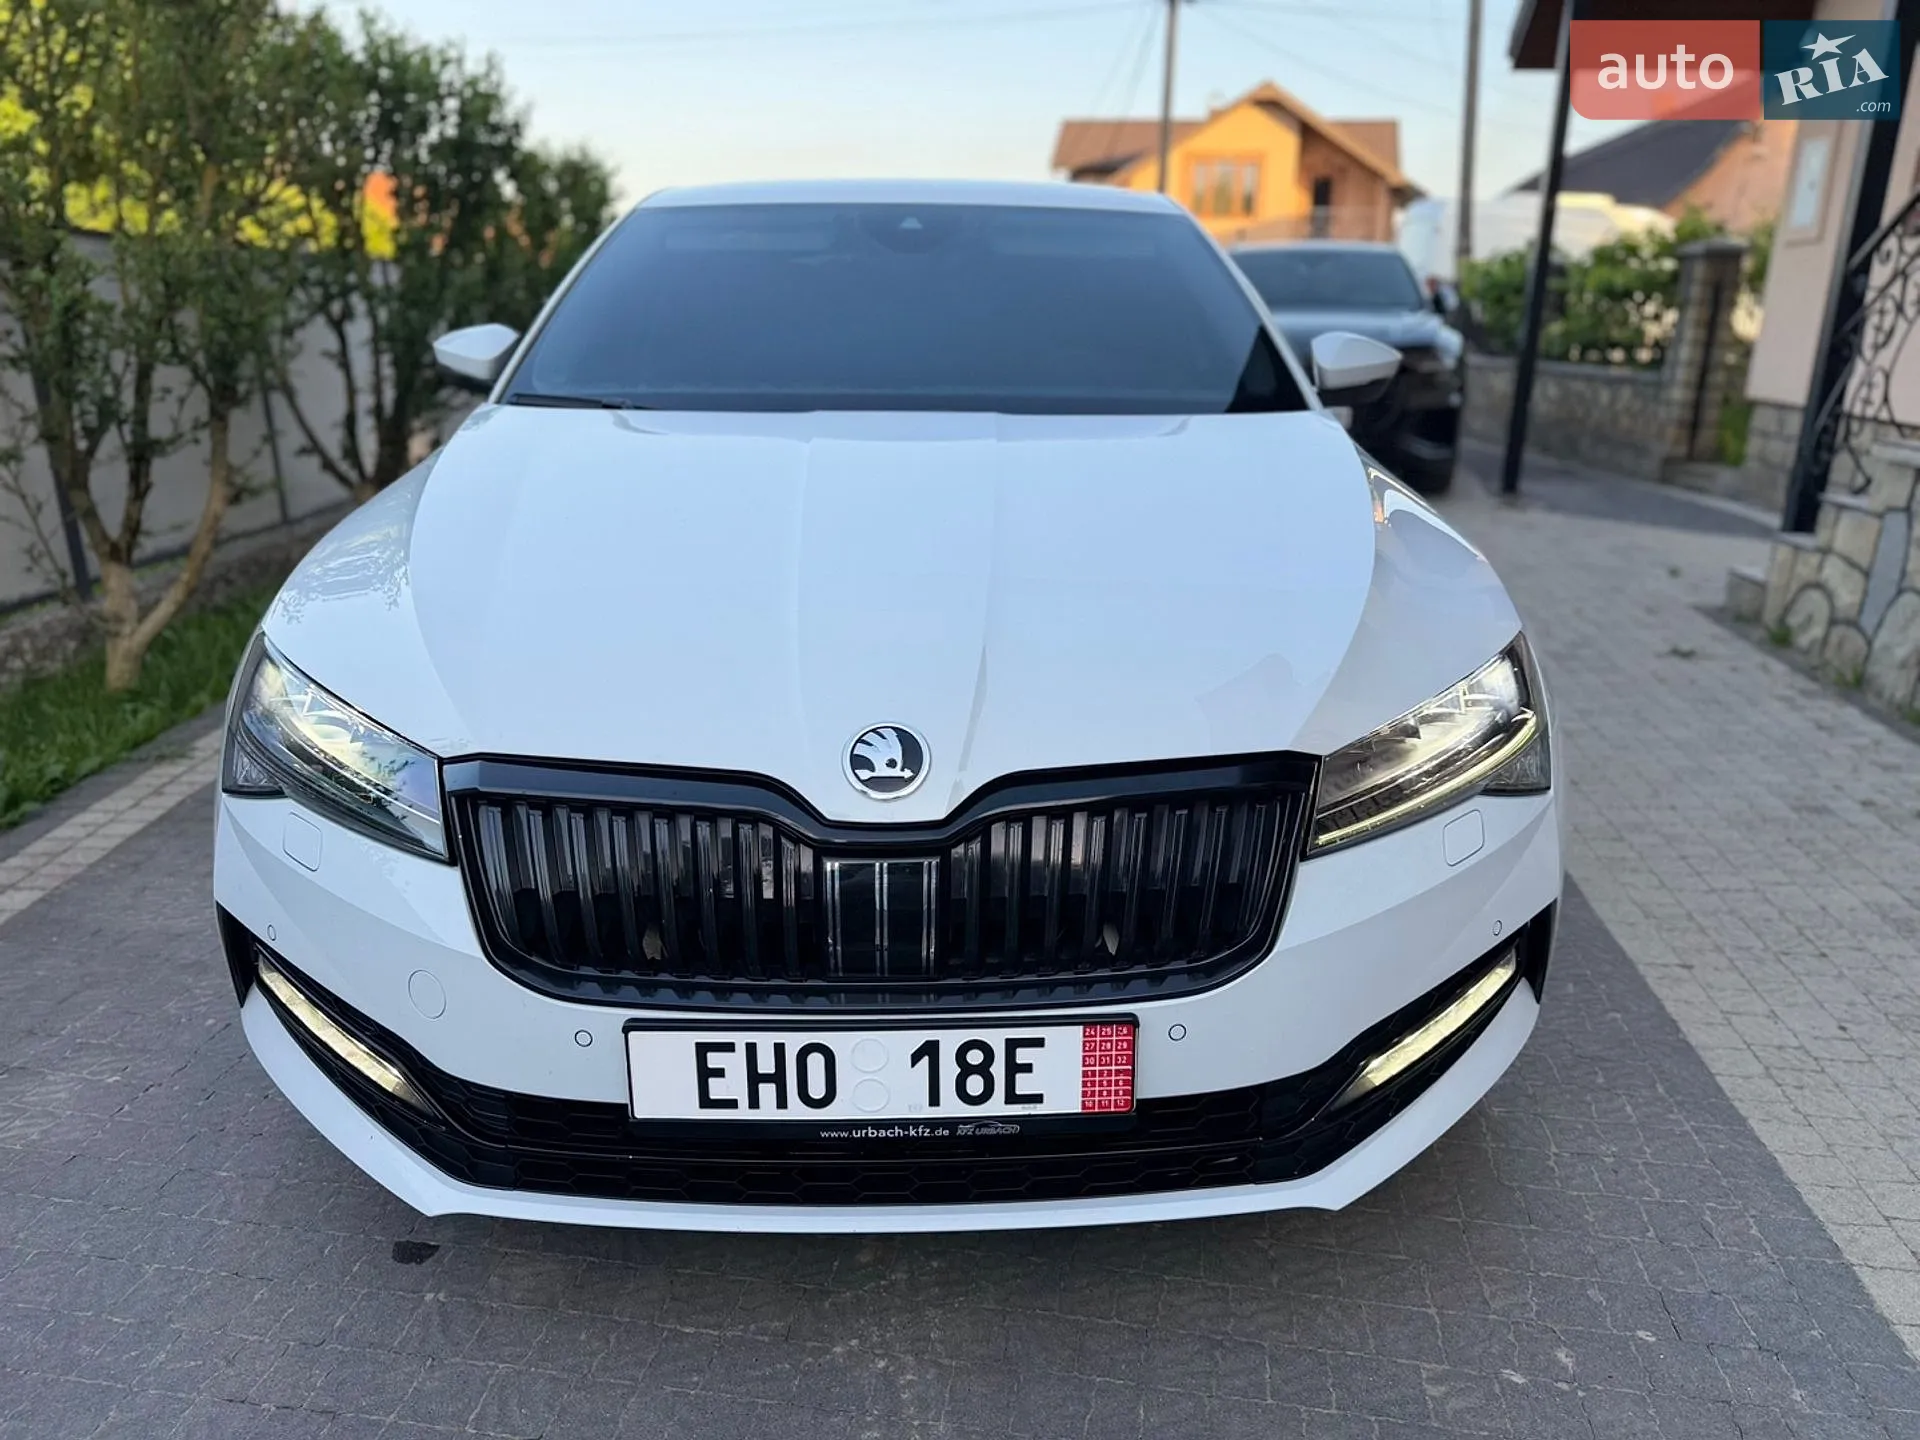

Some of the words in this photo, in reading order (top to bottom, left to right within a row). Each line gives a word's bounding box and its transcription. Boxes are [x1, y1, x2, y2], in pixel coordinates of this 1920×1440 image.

[1085, 1027, 1095, 1036] 24
[1085, 1042, 1095, 1050] 27
[1101, 1042, 1111, 1050] 28
[1084, 1057, 1095, 1065] 30
[1100, 1055, 1111, 1065] 31
[1116, 1055, 1127, 1065] 32
[910, 1037, 1046, 1108] 18E
[819, 1125, 951, 1139] www.urbach-kfz.de
